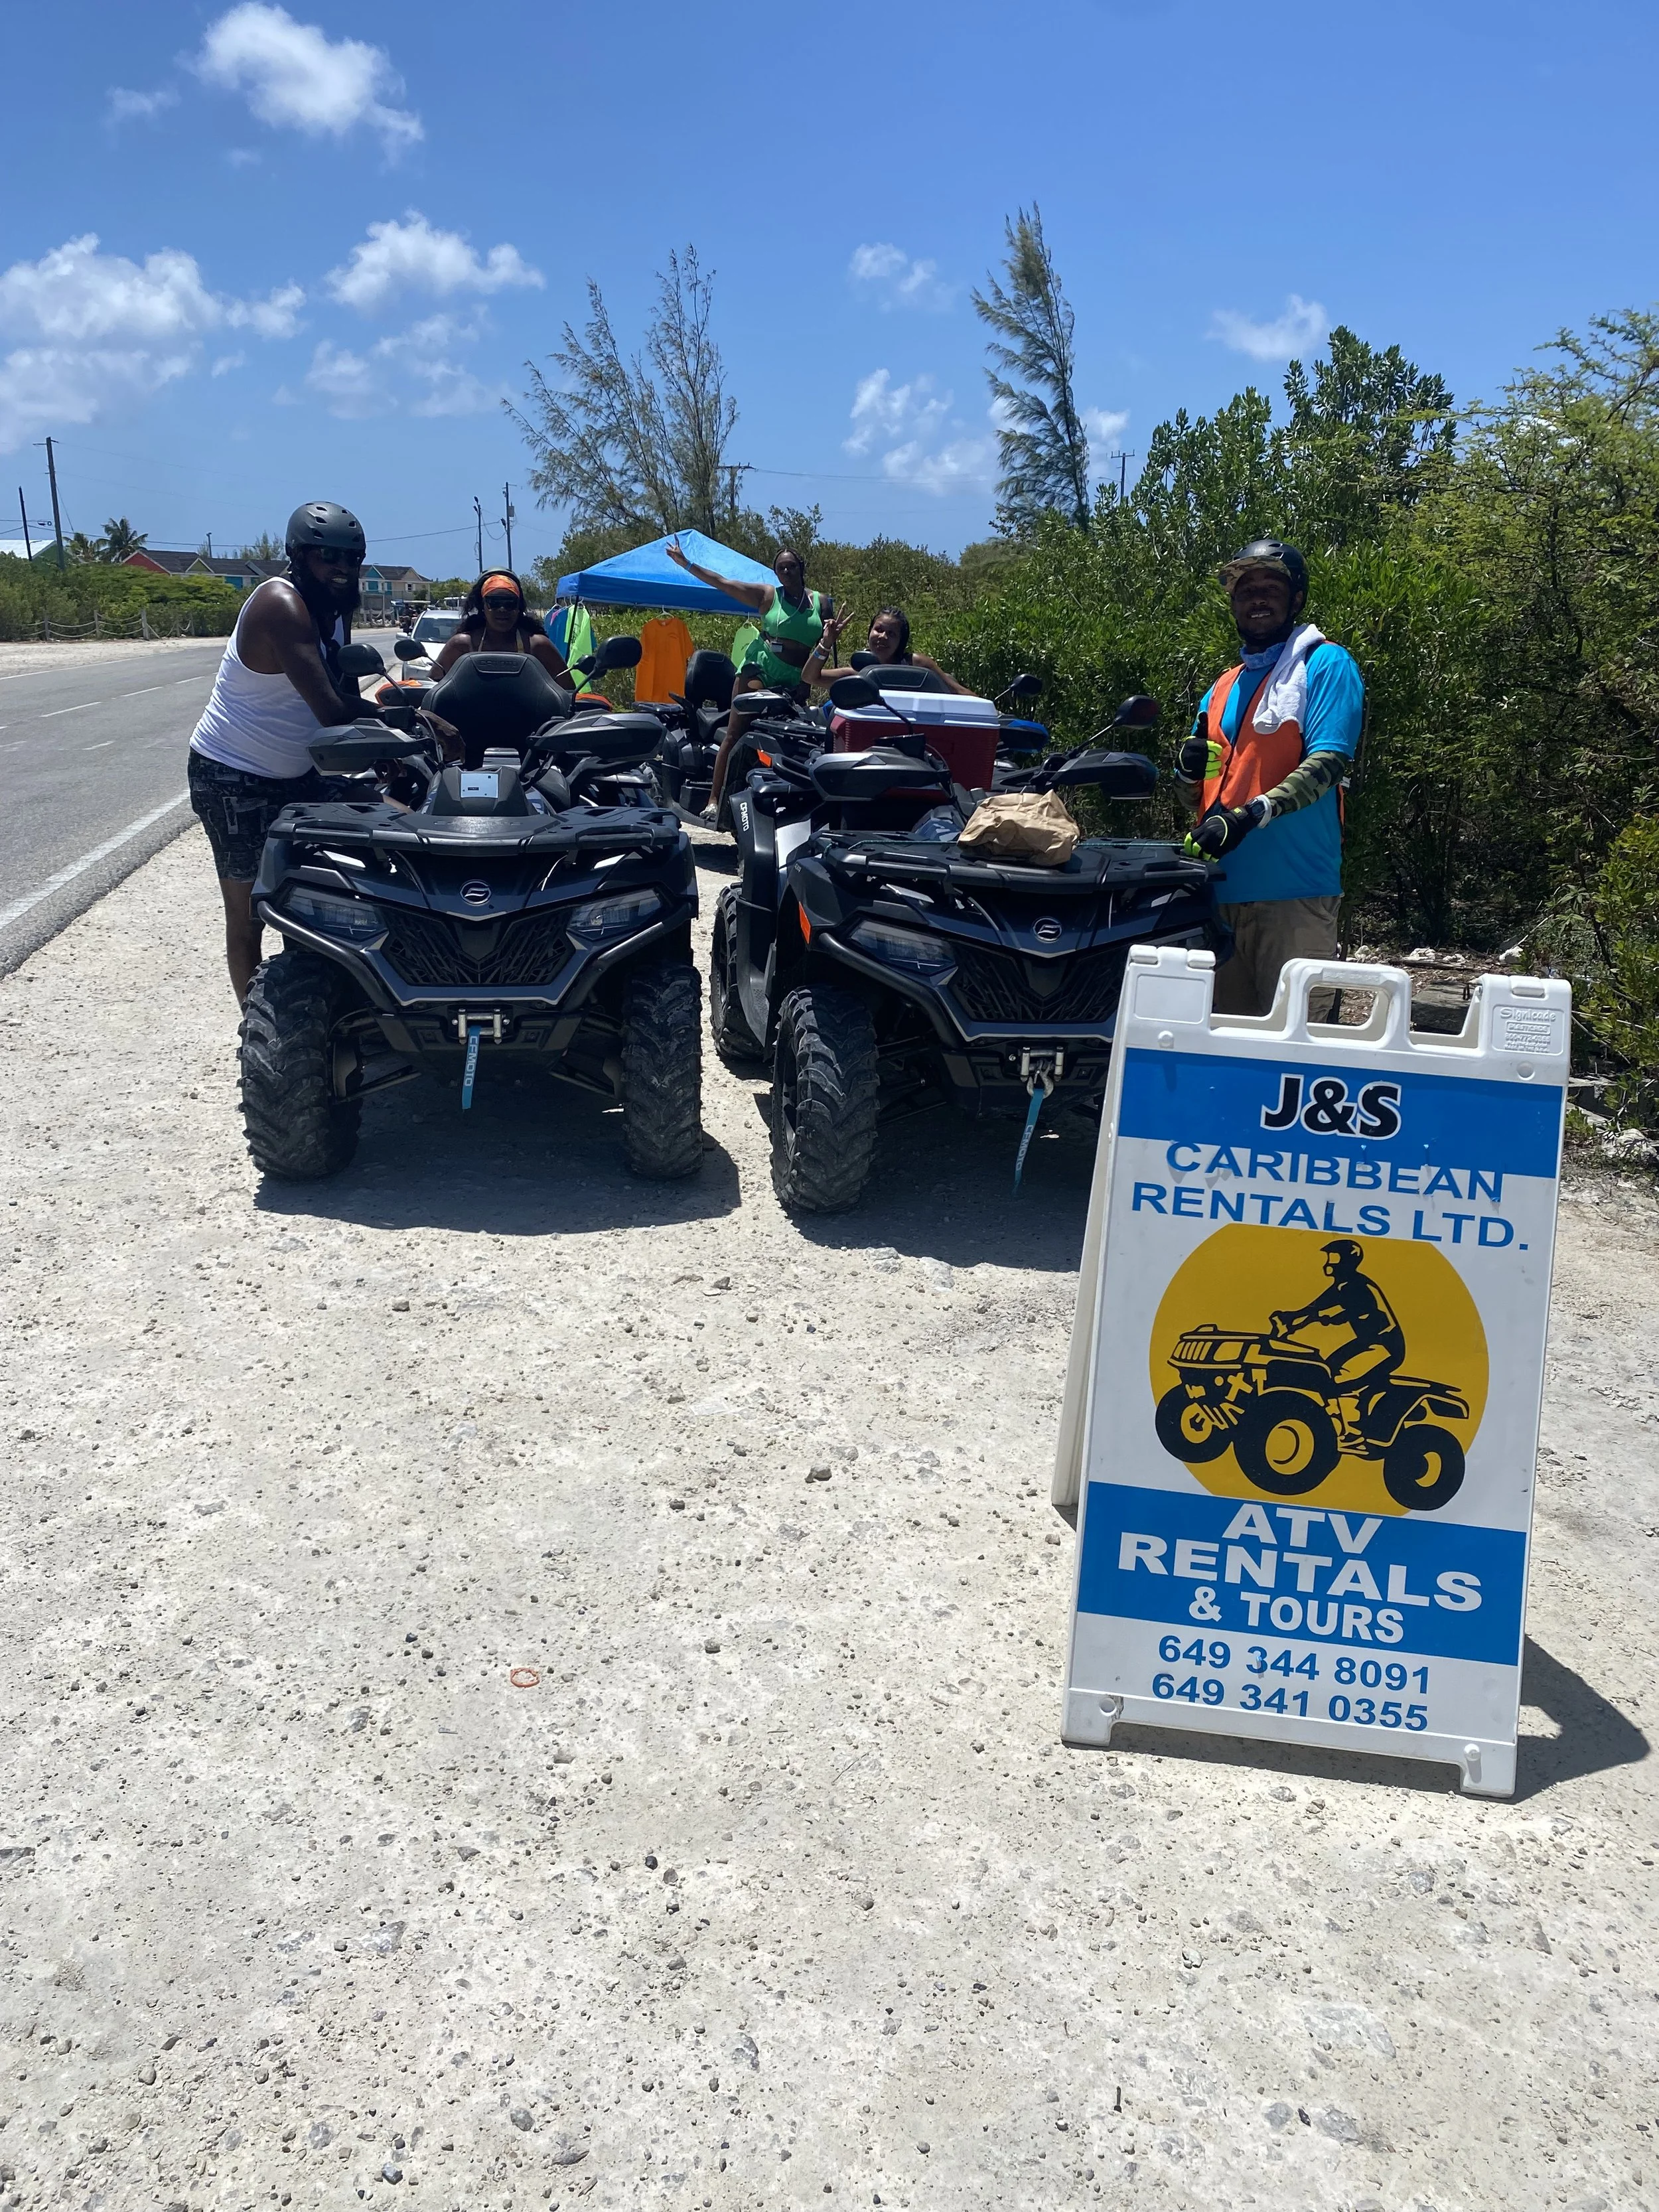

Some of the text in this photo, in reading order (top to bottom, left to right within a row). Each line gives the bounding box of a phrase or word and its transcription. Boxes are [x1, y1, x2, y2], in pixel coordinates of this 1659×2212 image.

[740, 802, 749, 832] CFMOTO
[1500, 1007, 1556, 1022] Signicade
[465, 1035, 478, 1086] CFMOTO
[1261, 1073, 1402, 1140] J&S
[1015, 1124, 1035, 1171] CFMOTO
[1167, 1140, 1503, 1202] CARIBBEAN
[1132, 1182, 1528, 1250] RENTALS LTD.
[1222, 1503, 1382, 1554] ATV
[1118, 1532, 1483, 1612] RENTALS
[1189, 1585, 1404, 1644] & TOURS
[1159, 1635, 1429, 1694] 649 344 8091
[1152, 1673, 1427, 1731] 649 341 0355
